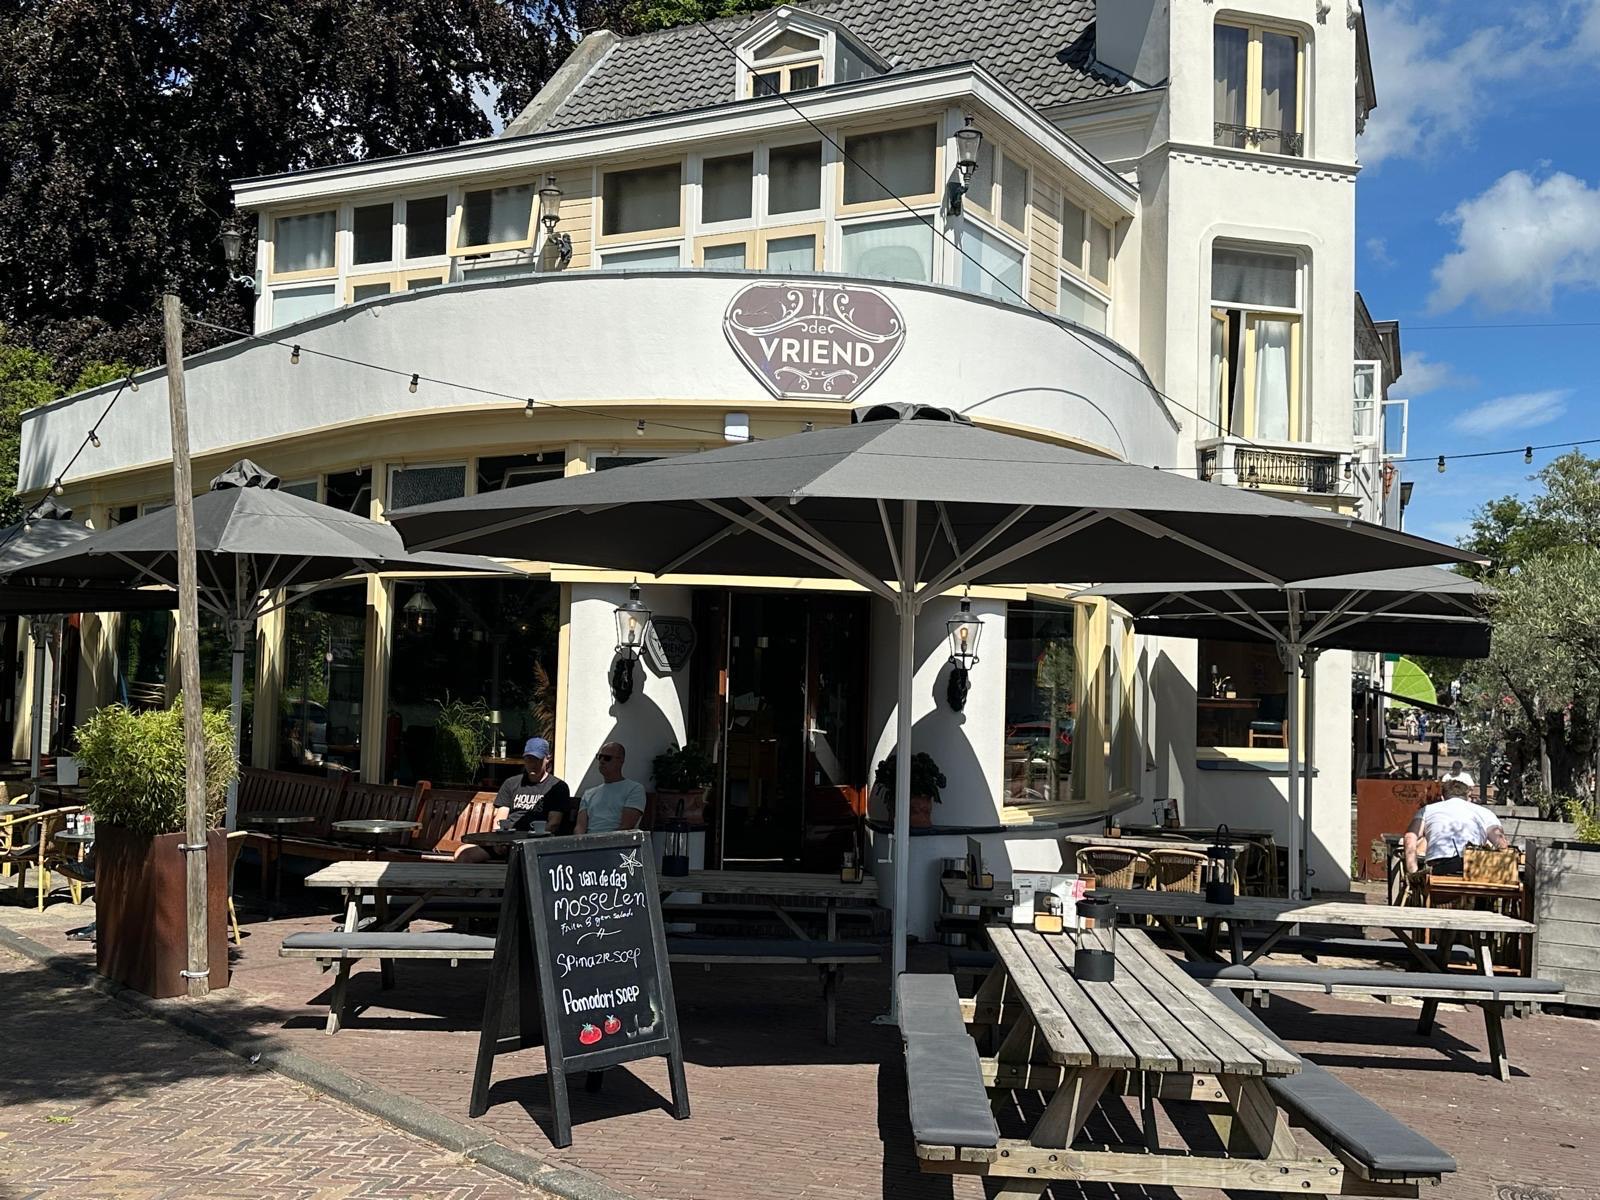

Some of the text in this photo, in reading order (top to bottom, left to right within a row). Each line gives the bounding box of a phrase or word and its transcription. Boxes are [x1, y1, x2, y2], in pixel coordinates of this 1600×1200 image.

[809, 320, 827, 334] de
[758, 337, 875, 367] VRIEND
[578, 870, 598, 887] van
[599, 869, 609, 887] de
[609, 868, 628, 890] dag
